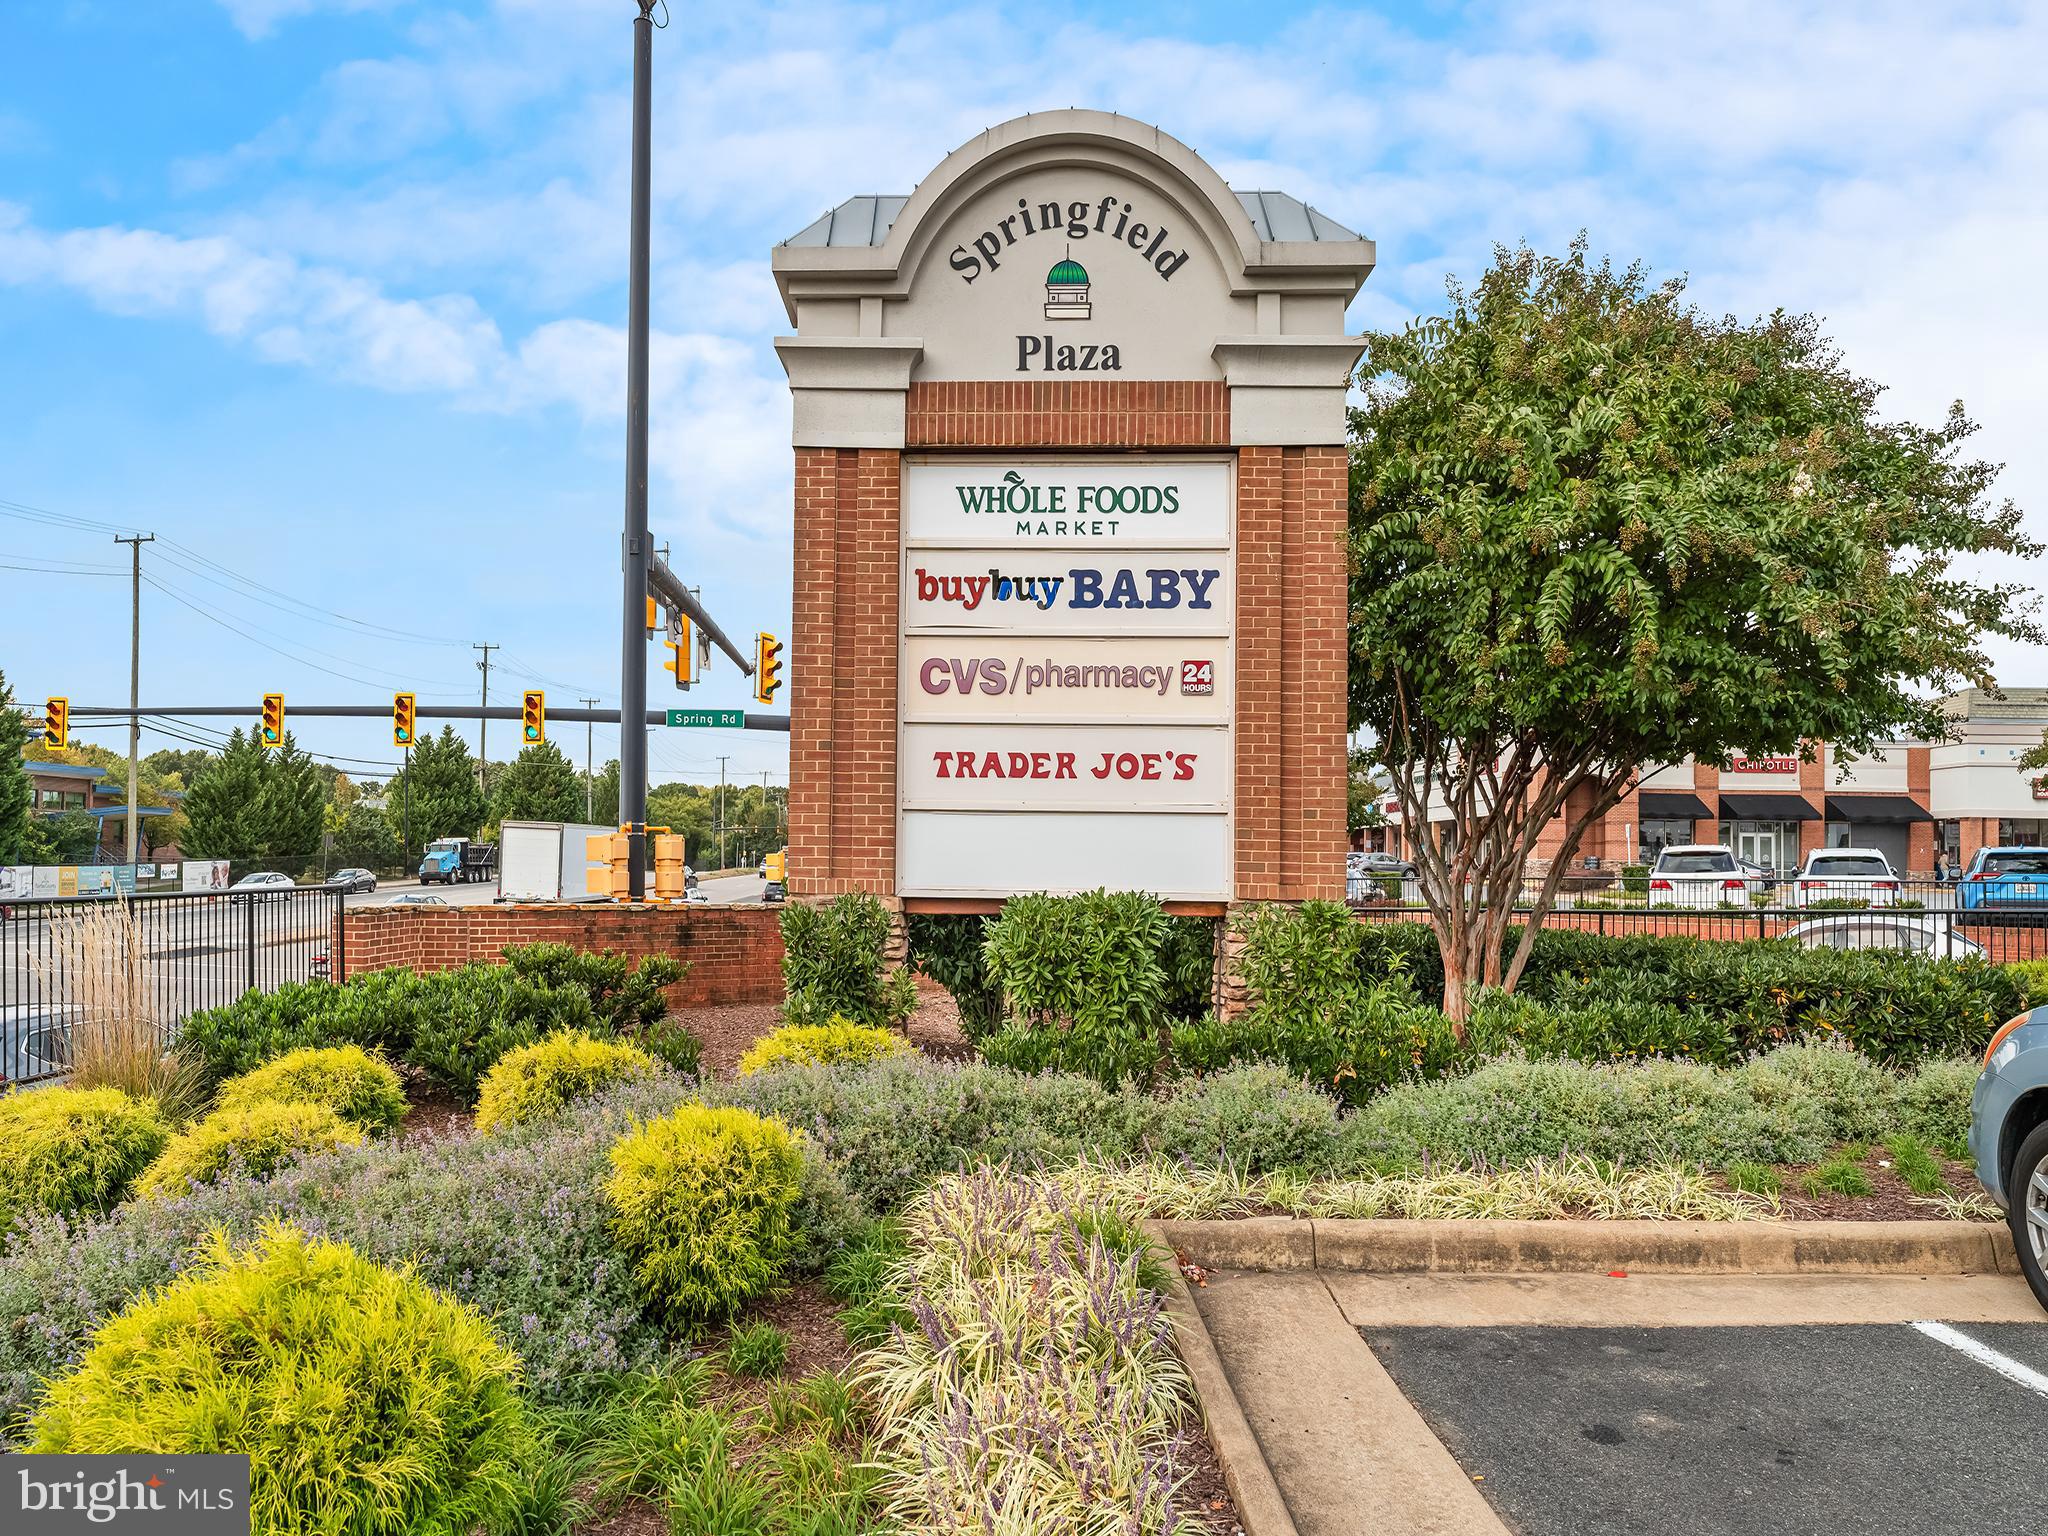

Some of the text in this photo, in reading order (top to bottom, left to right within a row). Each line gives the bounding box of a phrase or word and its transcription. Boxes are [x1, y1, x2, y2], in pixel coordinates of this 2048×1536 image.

[949, 196, 1190, 285] Springfield
[1016, 336, 1122, 371] Plaza
[956, 478, 1180, 515] WHOLE FOODS
[1016, 521, 1120, 536] MARKET
[1068, 569, 1220, 610] BABY
[1183, 663, 1211, 683] 24
[1183, 684, 1211, 692] HOURS
[675, 713, 736, 726] Spring Rd
[933, 750, 1198, 781] TRADER JOE'S
[1738, 760, 1795, 770] CHIPOTLE
